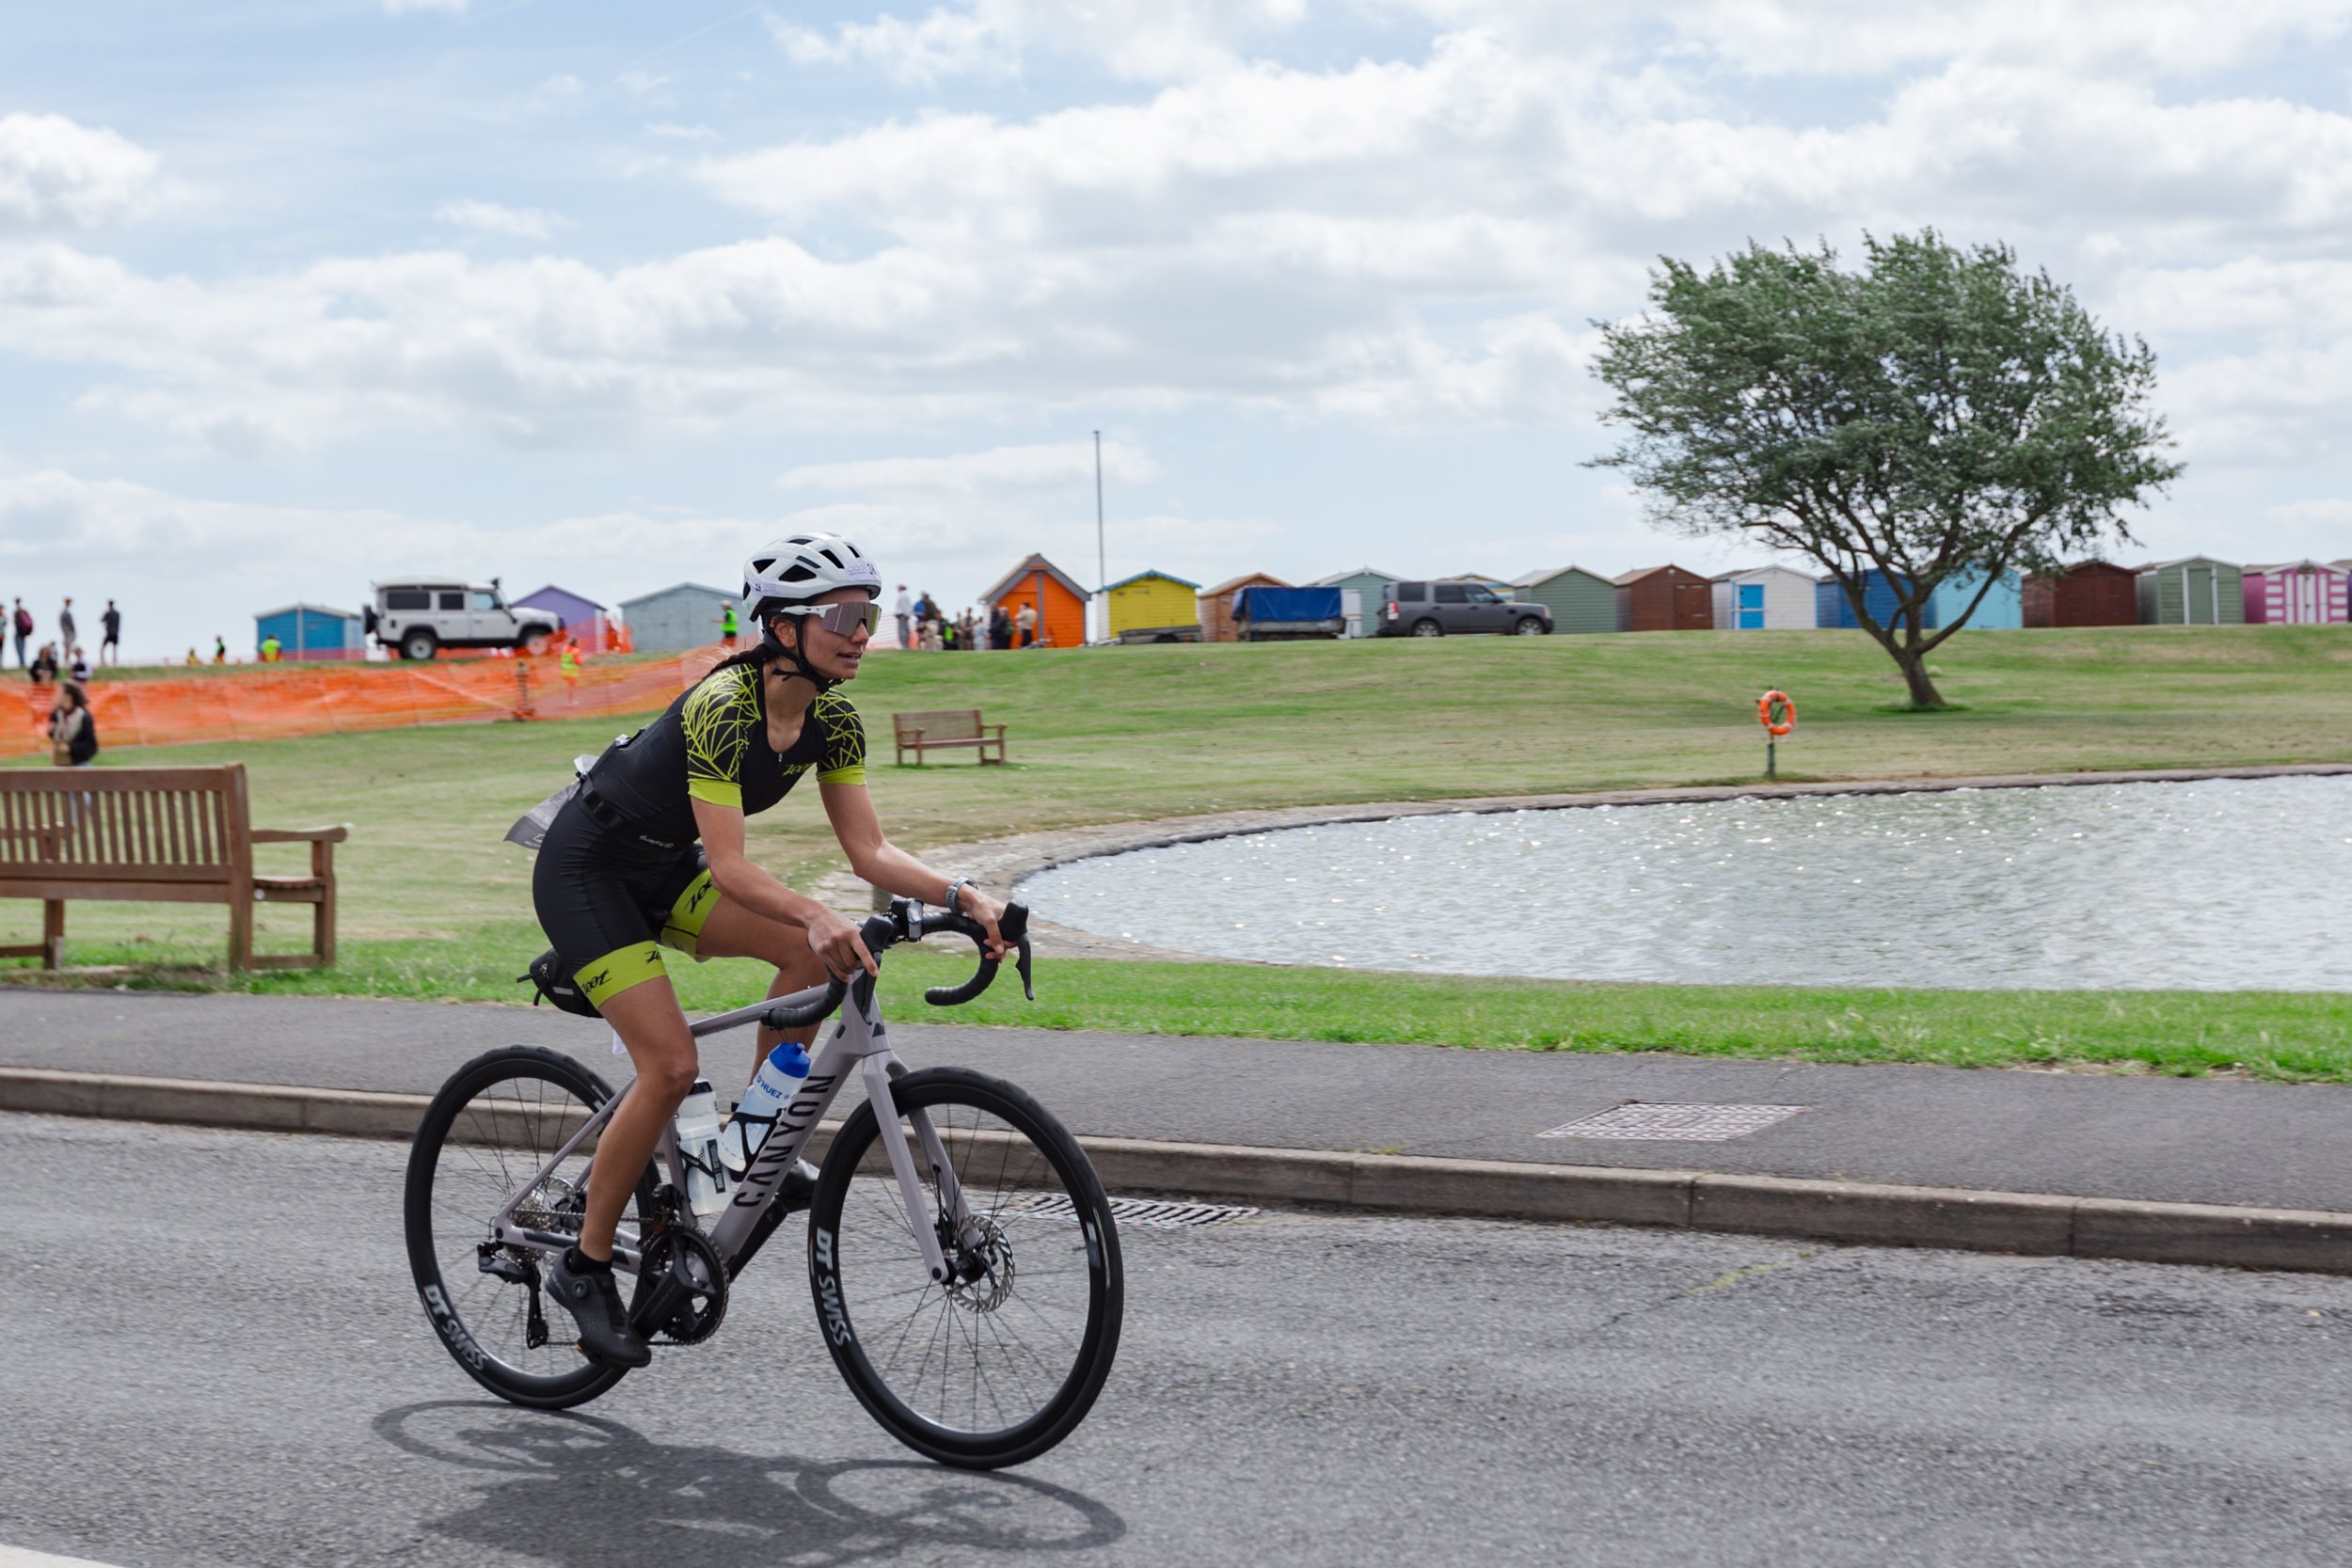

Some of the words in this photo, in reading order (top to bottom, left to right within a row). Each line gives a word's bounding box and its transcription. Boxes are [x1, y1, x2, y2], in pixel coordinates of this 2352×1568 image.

[755, 1074, 783, 1099] D'HUEZ
[733, 1075, 836, 1208] CANYON
[816, 1226, 833, 1270] DT
[422, 1284, 451, 1316] DT
[440, 1319, 488, 1370] SWISS
[818, 1274, 851, 1347] SWISS
